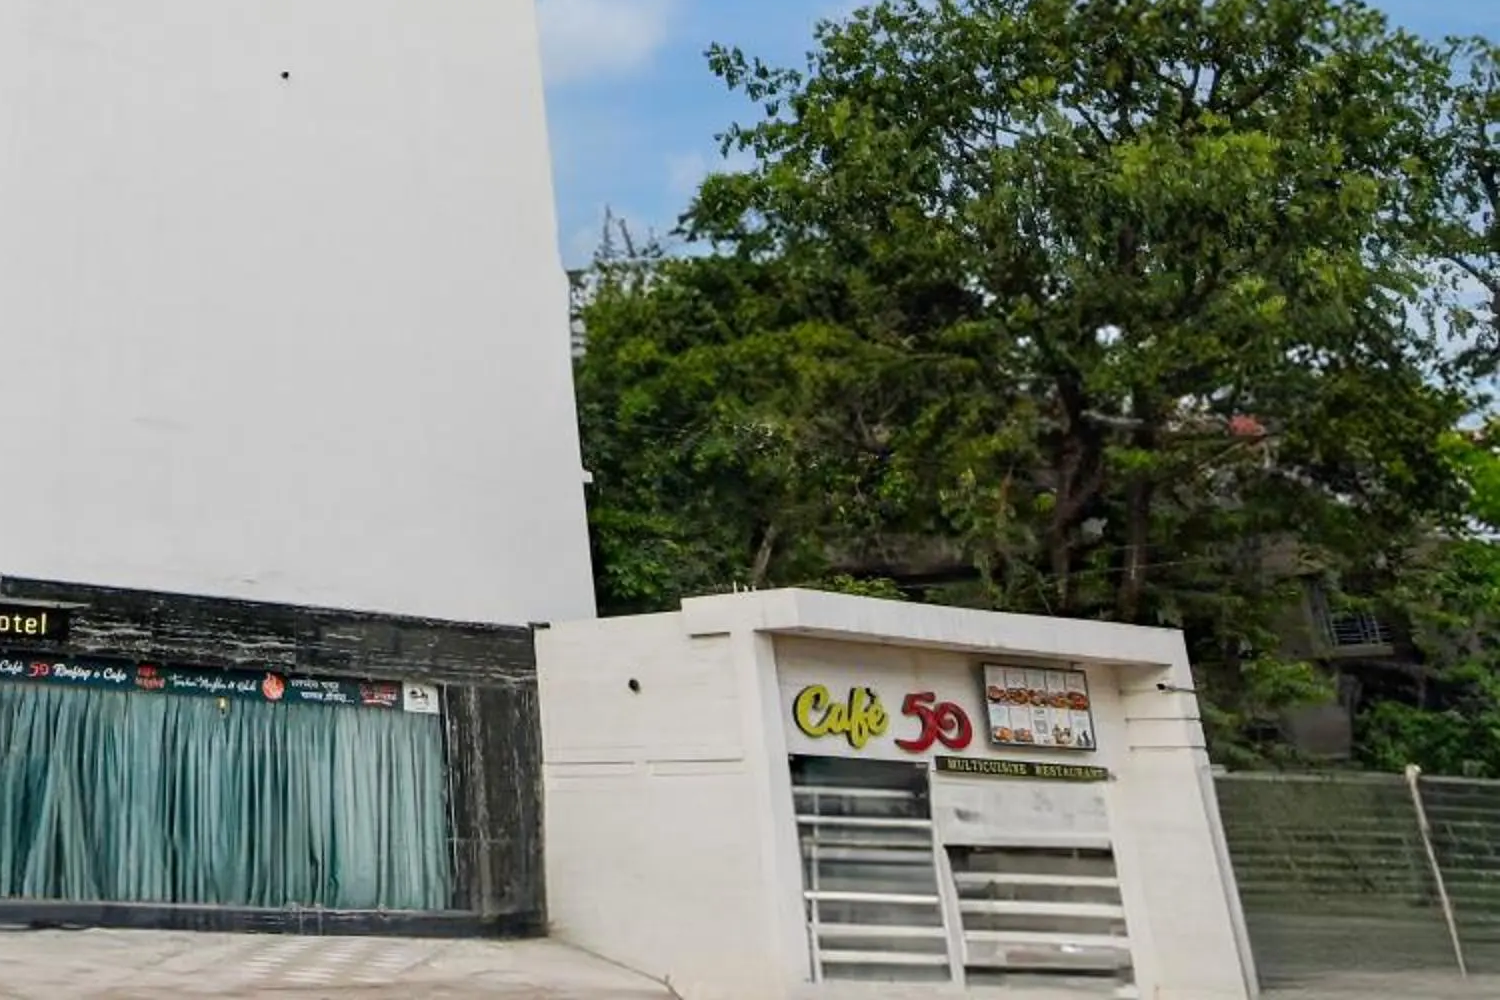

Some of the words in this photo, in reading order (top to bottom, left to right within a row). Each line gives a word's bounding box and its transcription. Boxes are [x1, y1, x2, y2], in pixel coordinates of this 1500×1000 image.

[894, 692, 973, 754] 50
[947, 758, 1027, 775] MULTICUISINE
[1035, 765, 1105, 779] RESTAURANT
